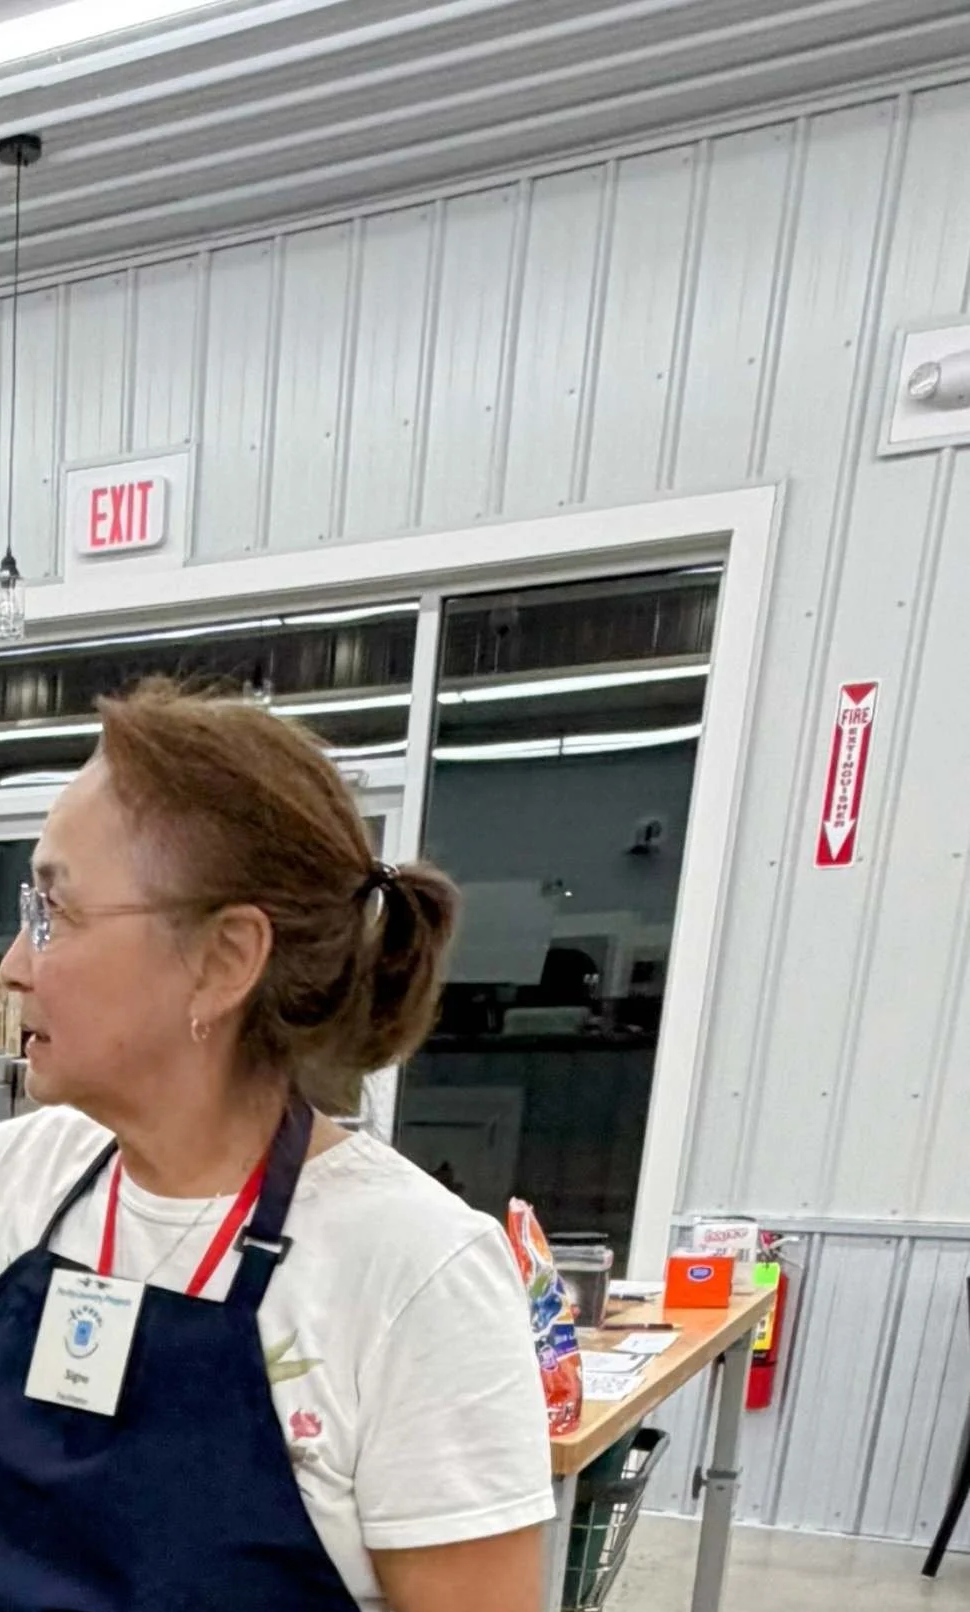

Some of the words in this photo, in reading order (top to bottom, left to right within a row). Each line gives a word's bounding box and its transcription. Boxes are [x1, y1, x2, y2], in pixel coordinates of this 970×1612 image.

[90, 479, 154, 547] EXIT
[841, 706, 871, 726] FIRE
[833, 727, 859, 828] EXTINGUISHER
